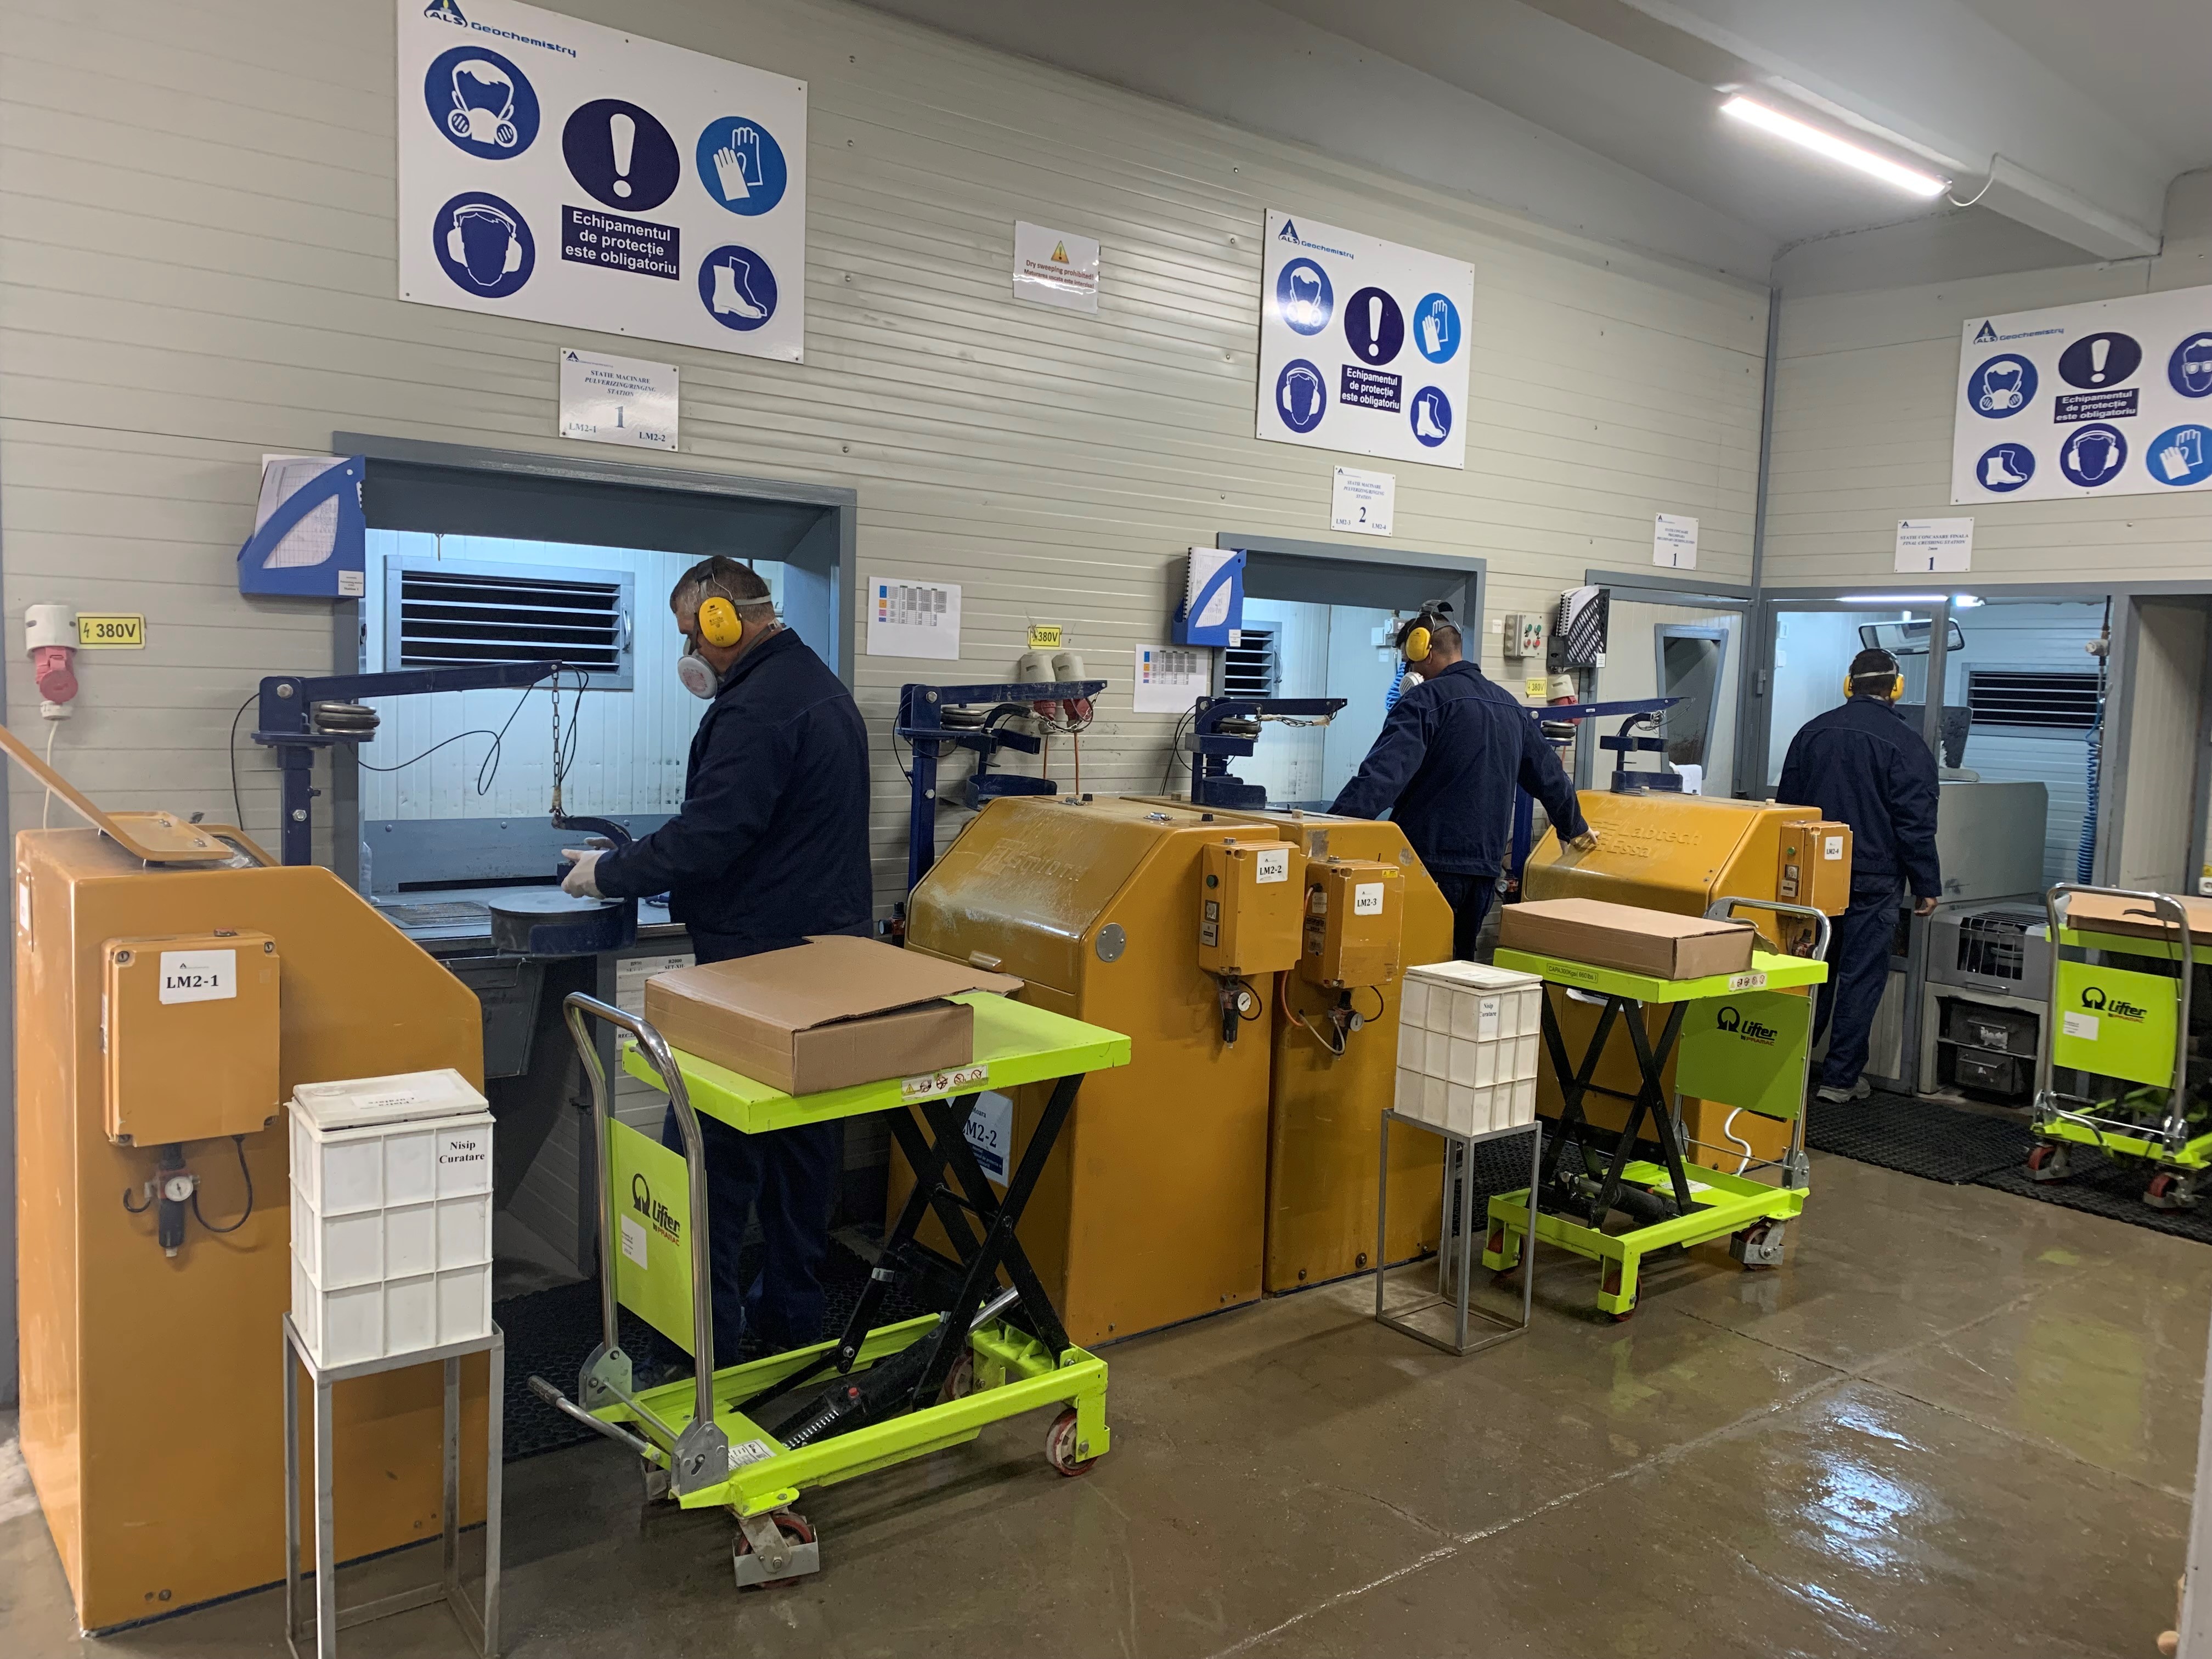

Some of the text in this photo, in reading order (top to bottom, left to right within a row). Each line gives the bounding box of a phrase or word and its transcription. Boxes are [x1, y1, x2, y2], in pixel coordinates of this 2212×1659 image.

[430, 11, 577, 58] ALS Geochemistry
[573, 210, 670, 241] Echipamentul
[579, 229, 664, 258] de protecție
[1281, 236, 1354, 259] ALS Geochemistry
[565, 245, 676, 274] este obligatoriu
[1026, 259, 1094, 280] Dry sweeping prohibited!
[2000, 328, 2064, 341] Geochemistry
[585, 377, 657, 392] PULVERIZING/RINGING
[591, 370, 651, 384] STATIE MACINARE
[1347, 368, 1398, 386] Echipamentul
[607, 388, 634, 397] STATION
[1350, 380, 1393, 398] de protecție
[2062, 391, 2132, 404] Echipamentul
[1342, 392, 1400, 409] este obligatoriu
[2081, 400, 2127, 411] protecție
[614, 405, 626, 428] 1
[2080, 408, 2136, 419] obligatoriu
[569, 422, 665, 442] LM2-1 LM2-2
[1359, 506, 1366, 523] 2
[1673, 552, 1677, 566] 1
[1928, 556, 1934, 570] 1
[96, 623, 136, 637] 380V
[1038, 631, 1058, 642] 380V
[1532, 683, 1544, 691] 380V
[1618, 823, 1702, 845] Labtech
[1607, 840, 1652, 857] Essa
[1260, 865, 1282, 875] LM2-2
[1357, 898, 1377, 907] LM2-3
[166, 975, 219, 989] LM2-1
[2108, 1000, 2147, 1018] Lifter
[1741, 1020, 1778, 1041] Lifter
[1746, 1036, 1775, 1046] PRAMAC
[963, 1120, 997, 1148] M2-2
[450, 1139, 476, 1150] Nisip
[439, 1153, 485, 1164] Curatare
[652, 1199, 680, 1238] Lifter
[658, 1227, 680, 1247] PRAMAC
